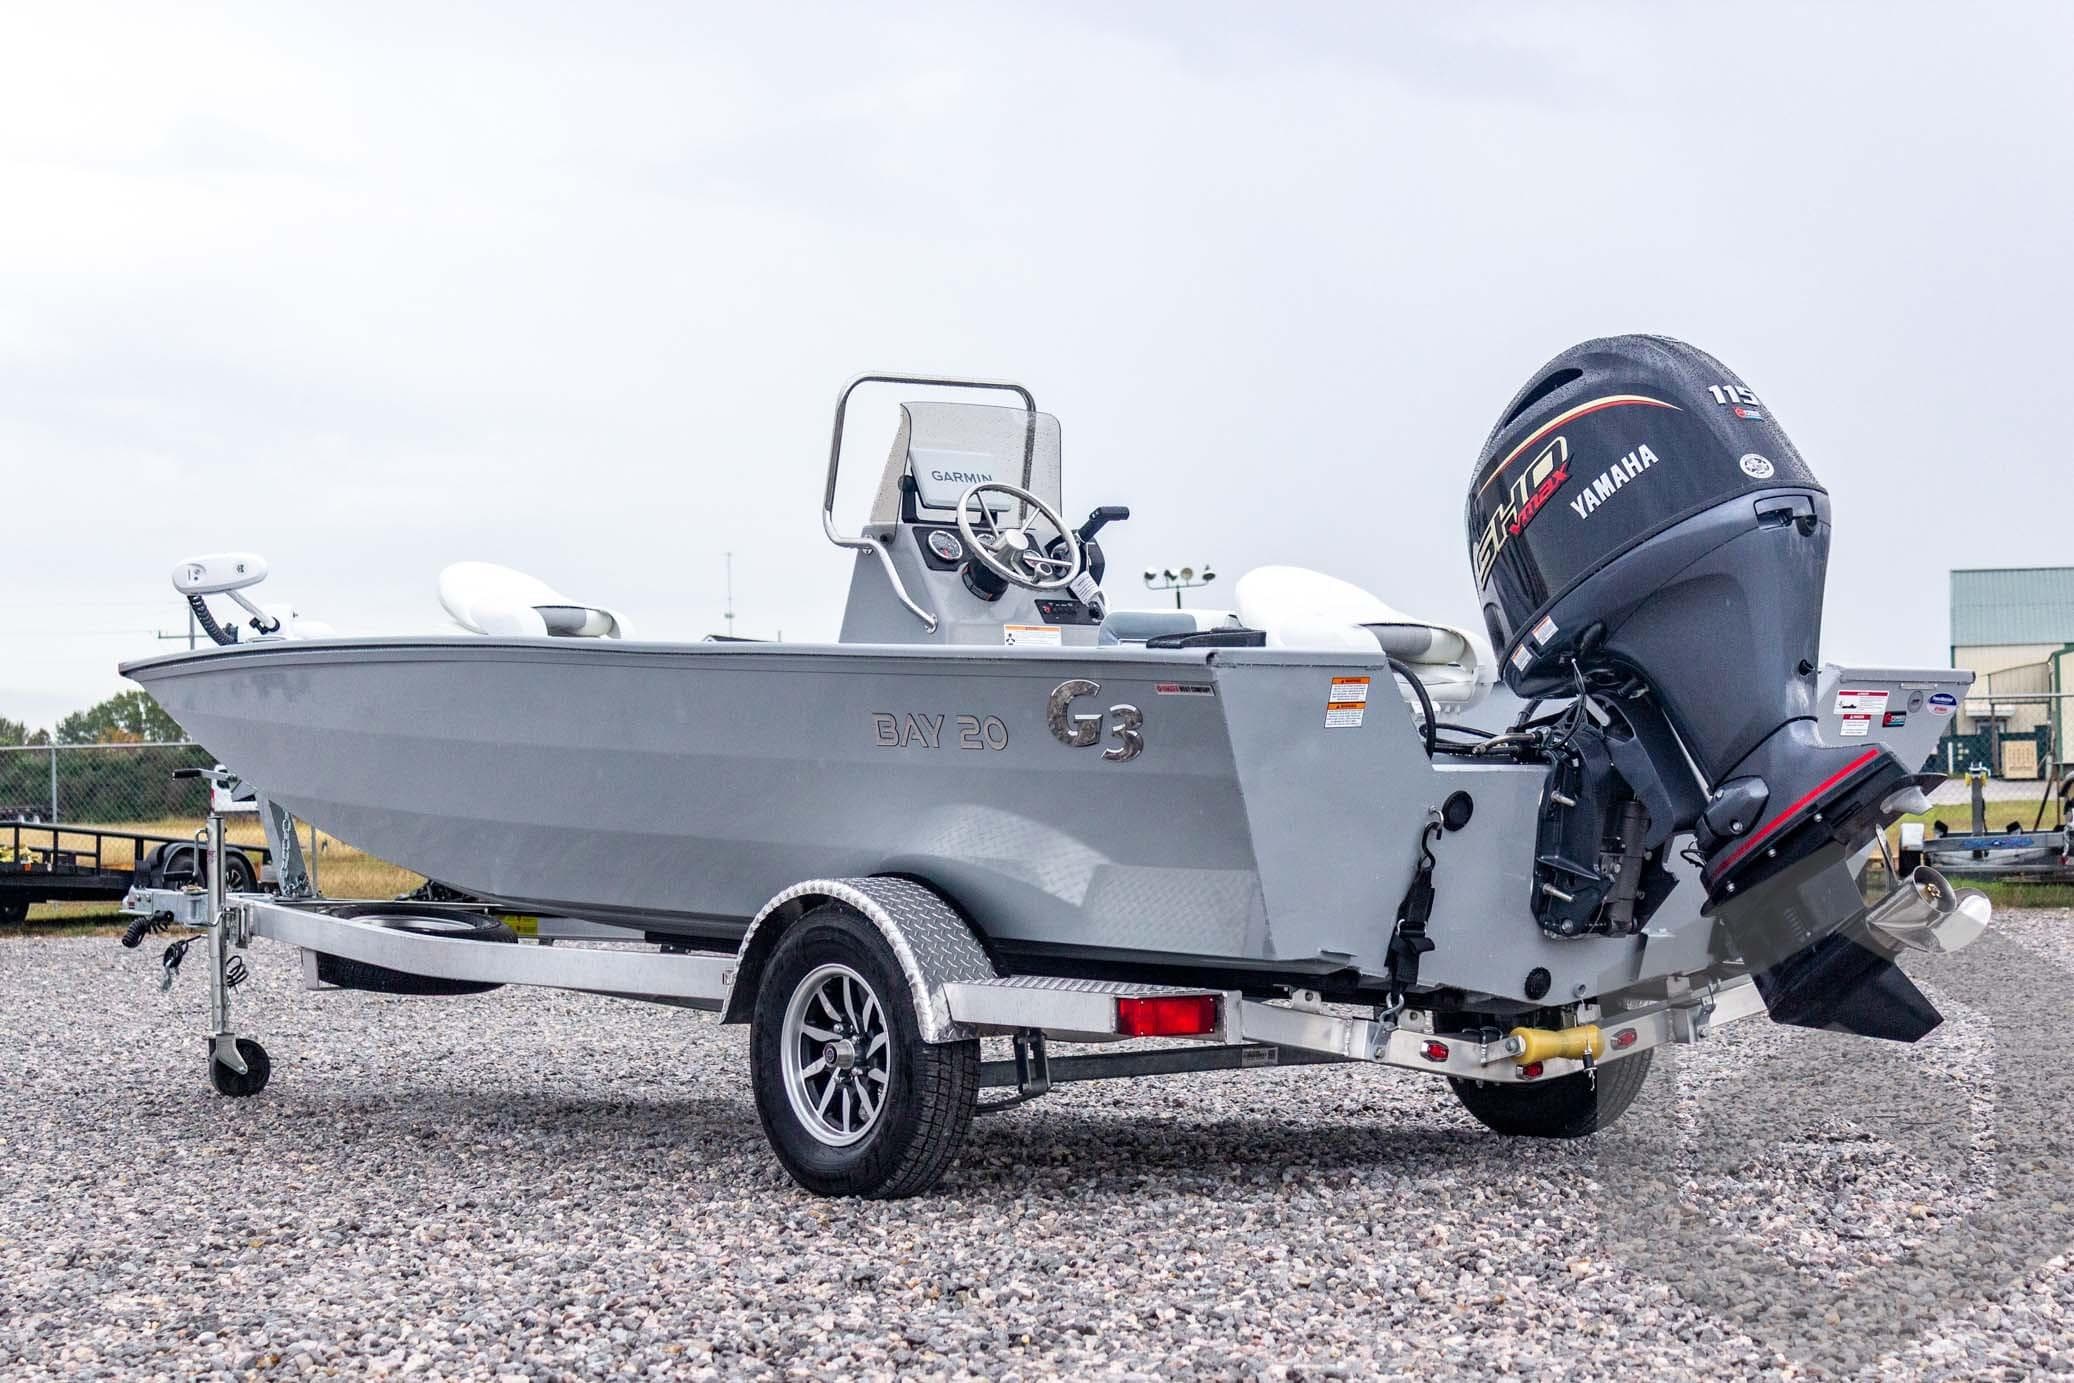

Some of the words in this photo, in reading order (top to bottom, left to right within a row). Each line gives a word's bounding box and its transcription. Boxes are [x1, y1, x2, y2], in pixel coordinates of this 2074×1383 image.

[1708, 384, 1760, 406] 115
[931, 470, 993, 484] GARMIN
[1570, 443, 1660, 521] YAMAHA
[871, 712, 945, 749] BAY
[956, 713, 1009, 751] 20
[1047, 678, 1145, 763] G3
